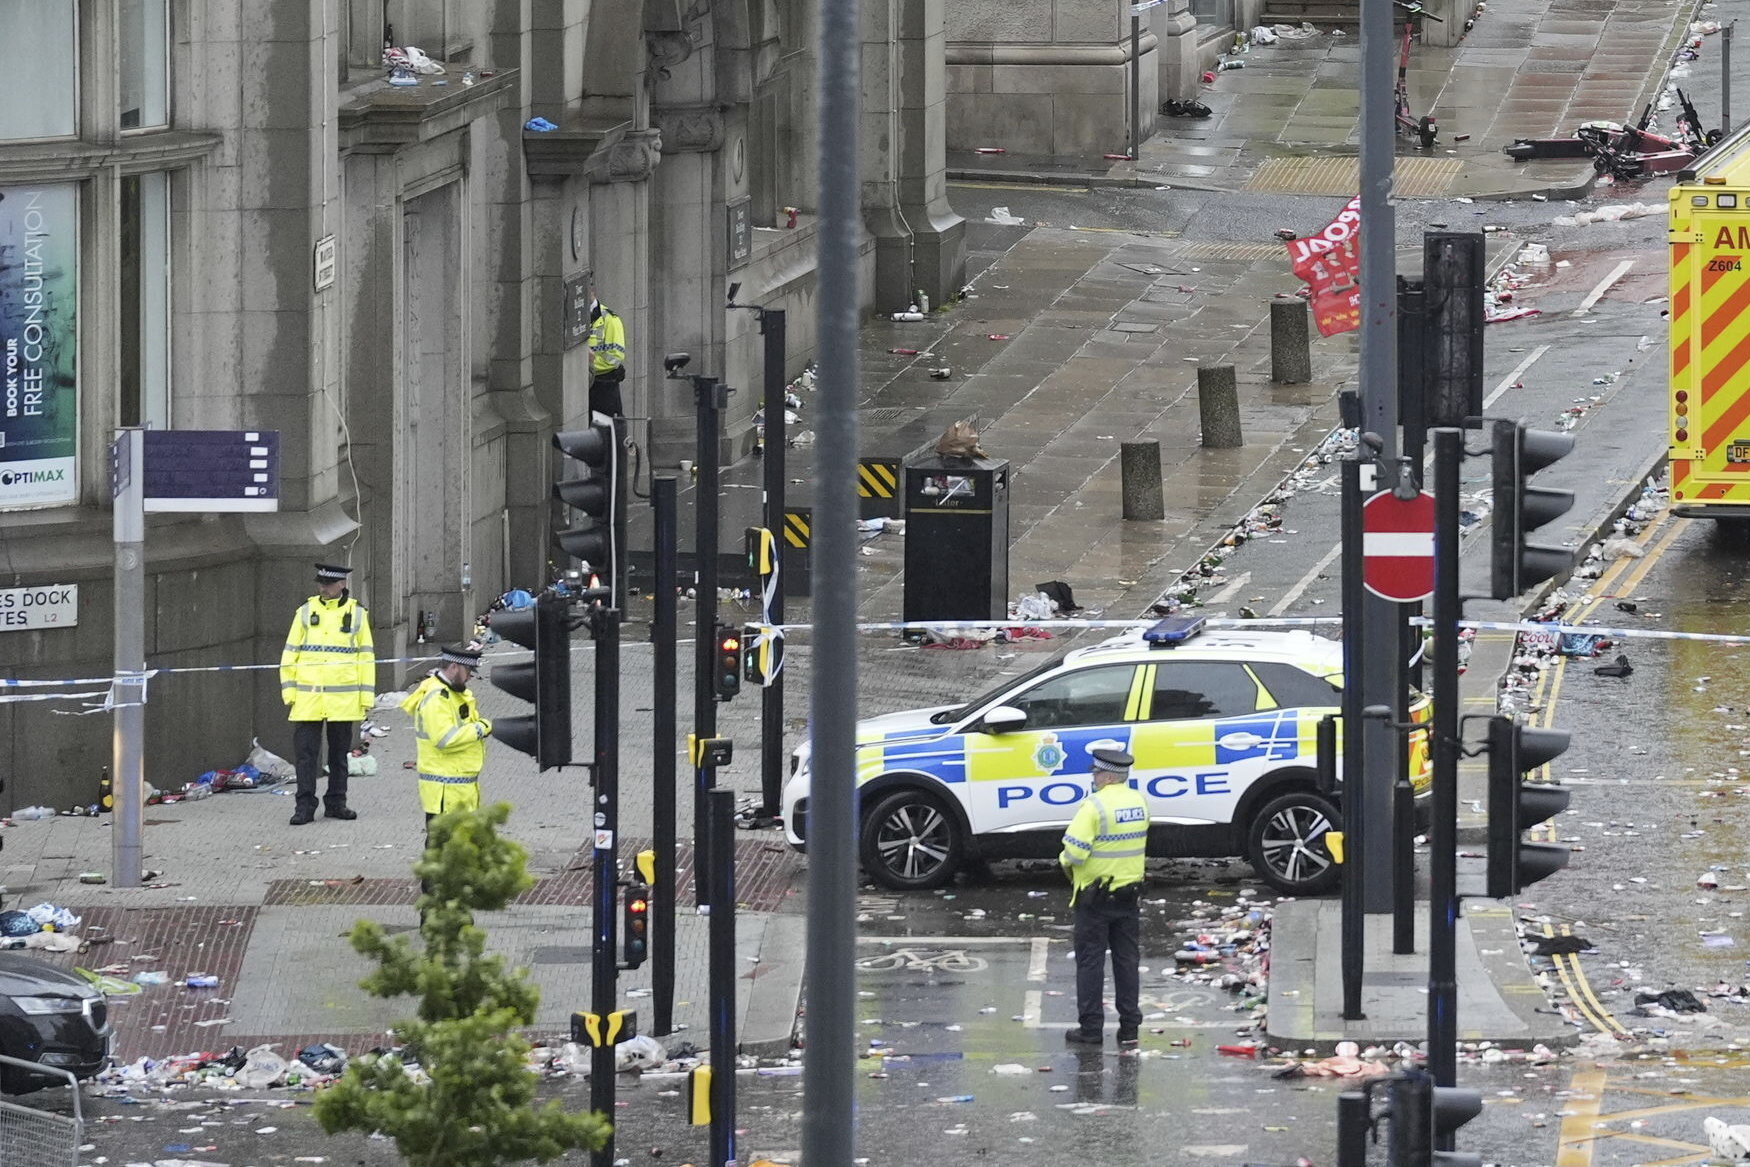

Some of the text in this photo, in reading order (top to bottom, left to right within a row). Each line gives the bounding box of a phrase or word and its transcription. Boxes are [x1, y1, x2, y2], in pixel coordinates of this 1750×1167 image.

[1708, 260, 1742, 272] Z604
[24, 191, 43, 416] FREE CONSULTATION
[6, 337, 18, 417] BOOK YOUR
[0, 469, 64, 485] OPTIMAX
[23, 590, 70, 607] DOCK
[44, 614, 57, 623] L2
[998, 772, 1231, 808] POCE
[1116, 808, 1145, 822] POLICE
